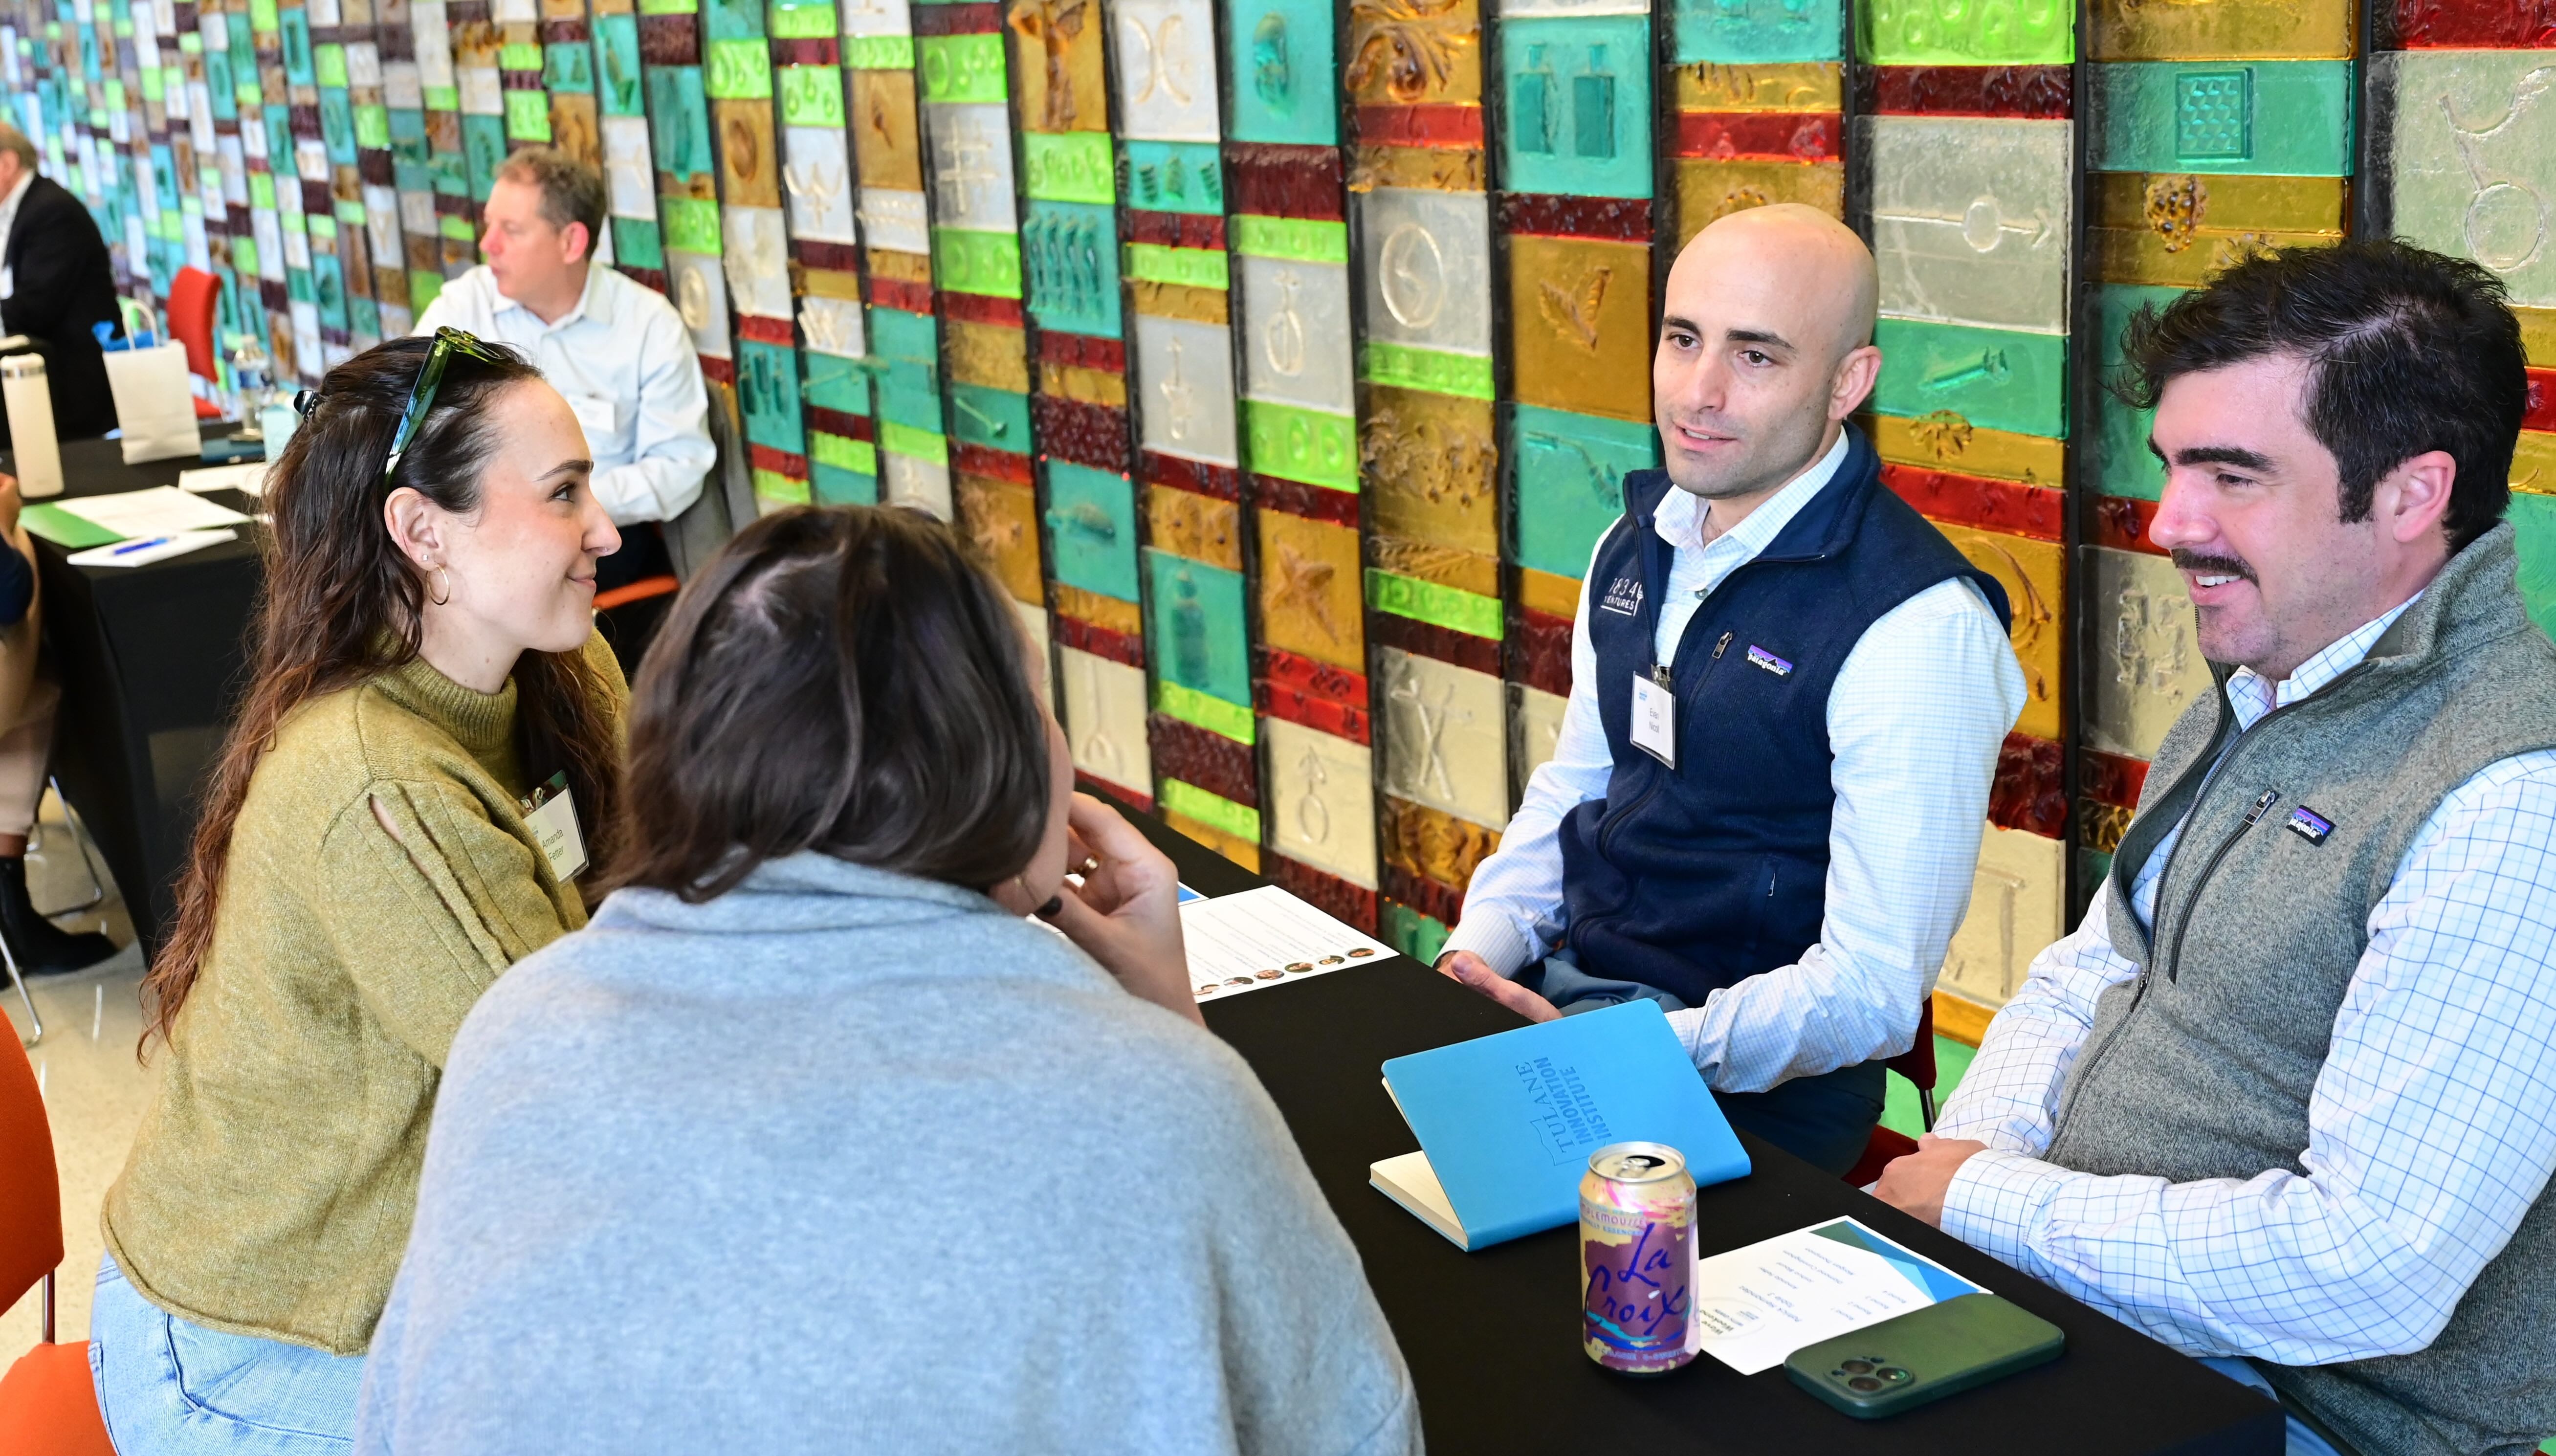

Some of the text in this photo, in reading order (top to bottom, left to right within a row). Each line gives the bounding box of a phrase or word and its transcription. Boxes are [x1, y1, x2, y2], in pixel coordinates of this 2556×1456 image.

[1609, 578, 1639, 598] 1834
[1747, 654, 1785, 676] patagonia
[542, 829, 563, 849] Amanda
[548, 845, 564, 862] Fetter
[1515, 1061, 1575, 1153] TULANE
[1533, 1057, 1594, 1145] INNOVATION
[1559, 1066, 1612, 1140] INSTITUTE
[1617, 1222, 1673, 1288] La
[1586, 1264, 1688, 1336] Croix
